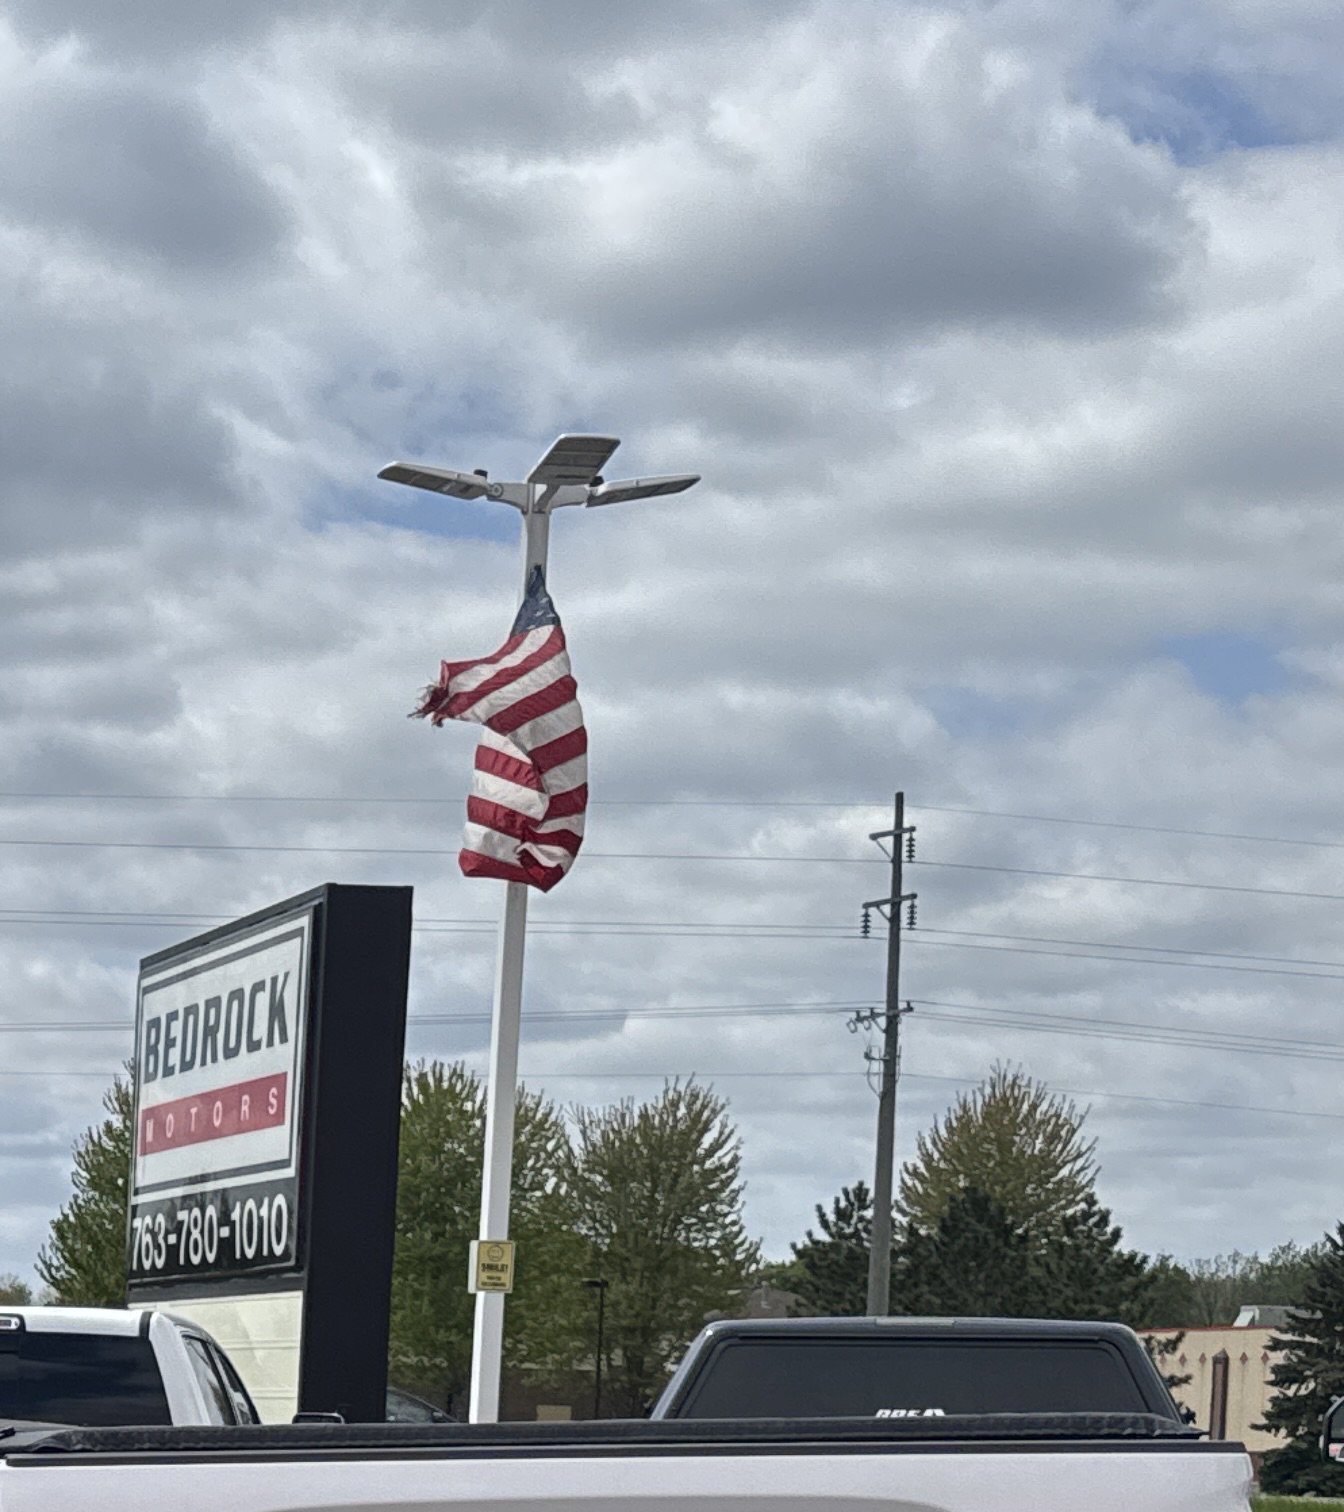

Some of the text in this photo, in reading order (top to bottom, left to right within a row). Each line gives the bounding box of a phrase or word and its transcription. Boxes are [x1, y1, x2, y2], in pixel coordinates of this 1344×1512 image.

[143, 970, 291, 1085] BEDROCK
[145, 1086, 279, 1143] MOTORS
[132, 1193, 289, 1272] 763-780-1010
